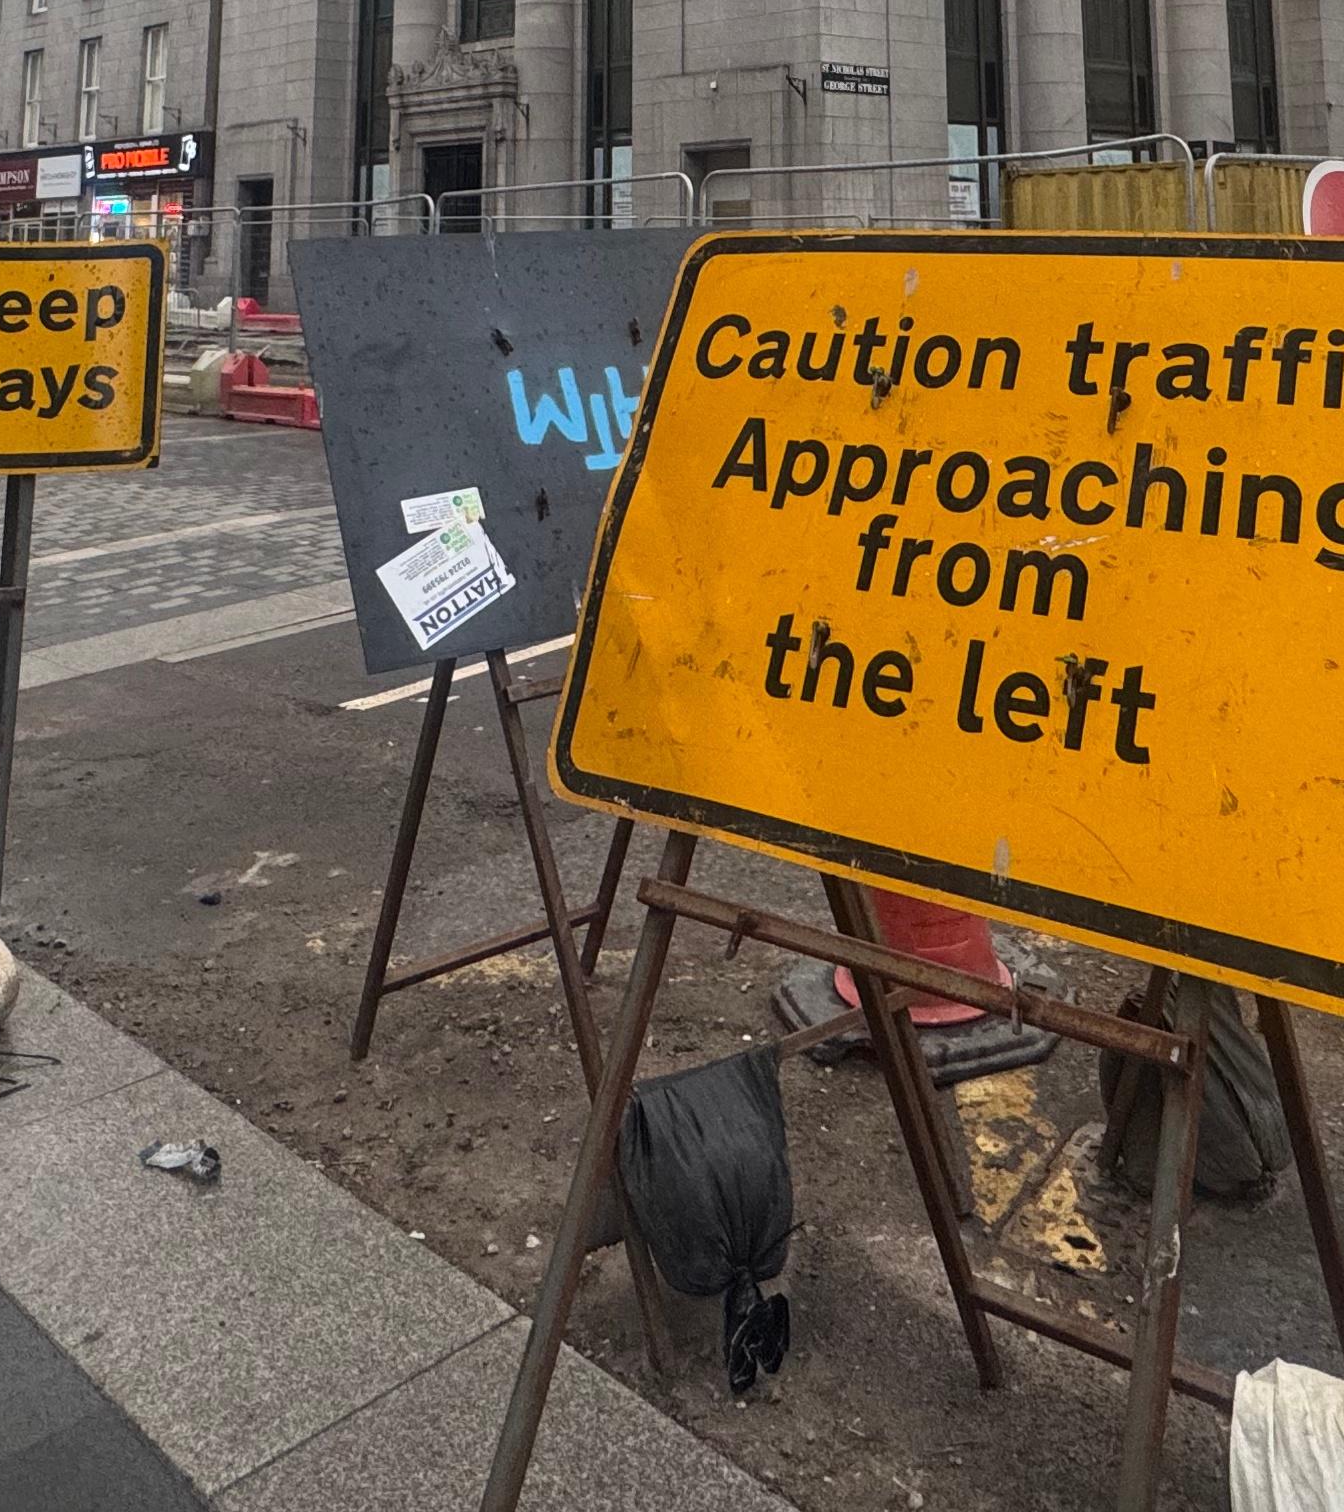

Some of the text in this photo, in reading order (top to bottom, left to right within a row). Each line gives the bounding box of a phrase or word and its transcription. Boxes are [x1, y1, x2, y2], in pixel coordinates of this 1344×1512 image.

[823, 80, 889, 95] GEORGE STREET
[830, 64, 865, 76] NICHOLAS
[865, 67, 889, 79] STREET
[100, 147, 170, 170] PRO MOBILE
[694, 312, 1023, 392] Caution
[448, 556, 472, 576] 01224
[856, 512, 1090, 621] from
[419, 569, 502, 637] HATTON
[762, 611, 1157, 765] the left
